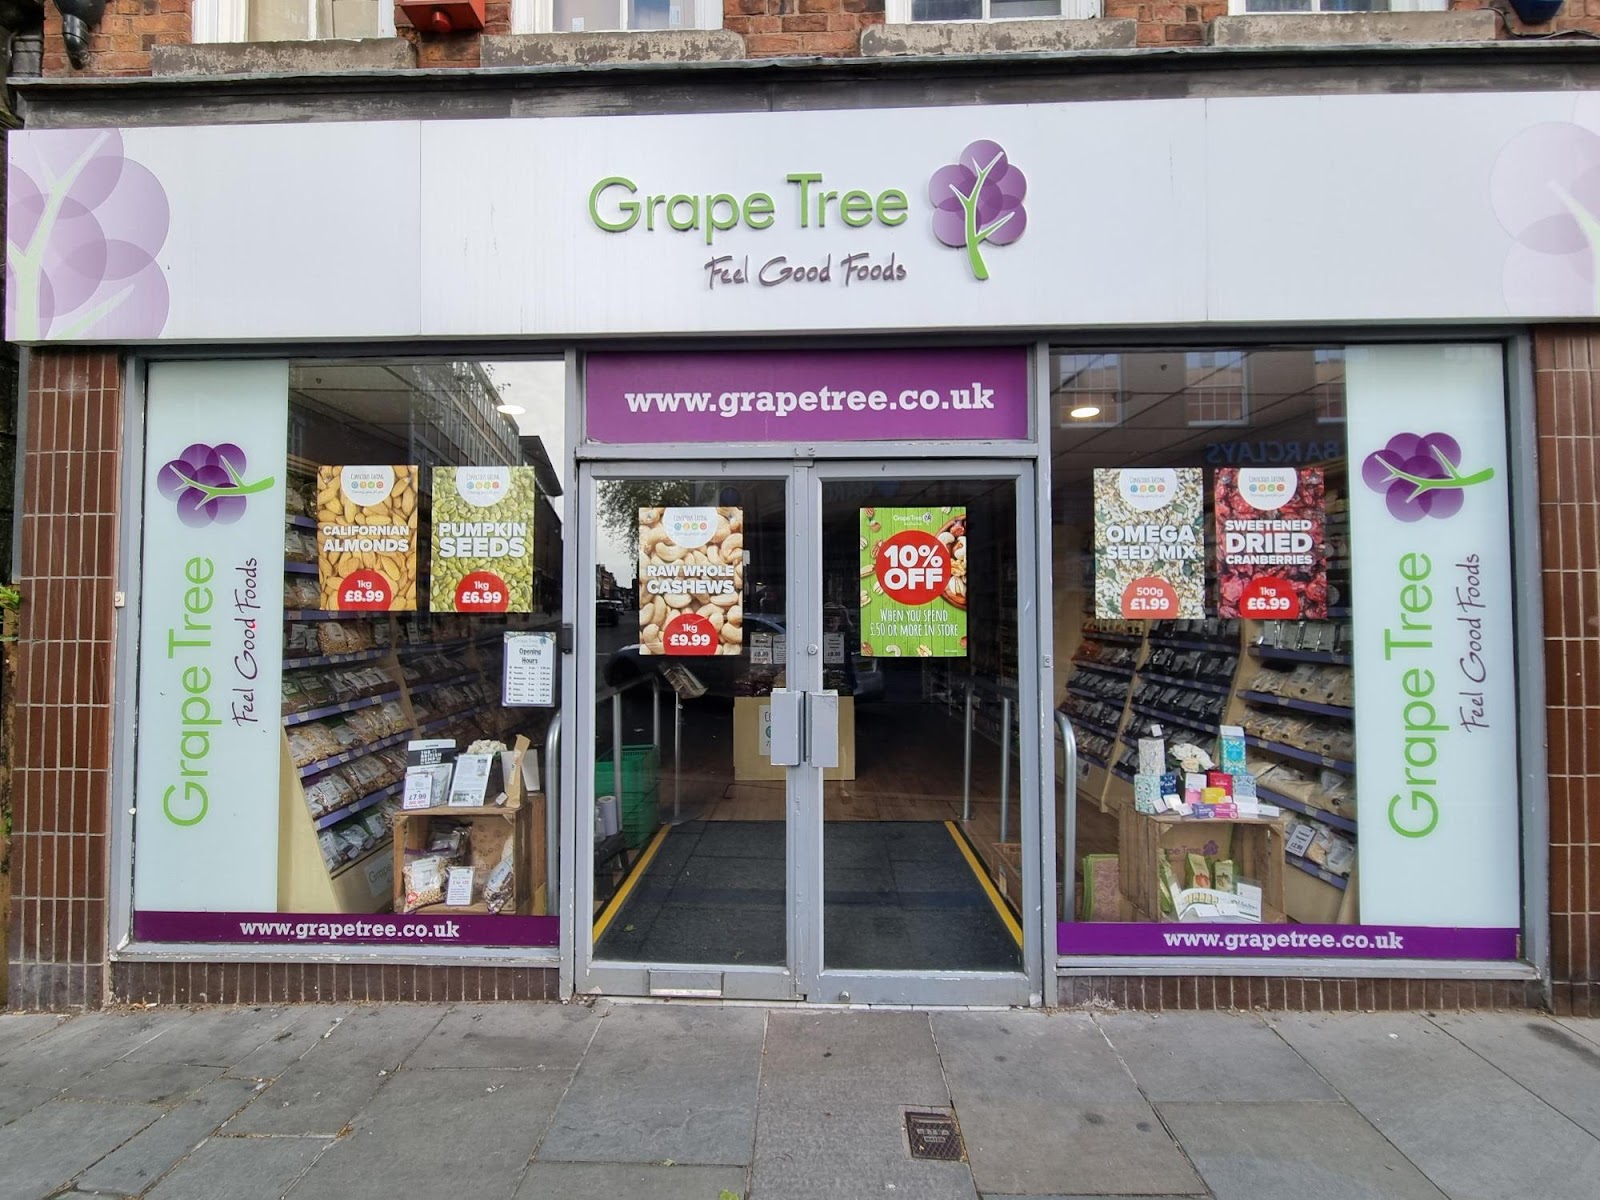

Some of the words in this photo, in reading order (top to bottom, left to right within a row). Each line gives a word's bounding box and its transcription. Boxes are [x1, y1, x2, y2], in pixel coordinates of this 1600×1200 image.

[588, 175, 775, 245] Grape
[786, 172, 909, 229] Tree
[704, 254, 749, 289] Feel
[758, 254, 831, 287] Good
[840, 252, 908, 287] Foods
[624, 382, 995, 418] www.grapetree.co.uk
[322, 525, 410, 536] CALIFORNIAN
[438, 522, 527, 537] PUMPKIN
[1225, 520, 1312, 531] SWEETENED
[1106, 525, 1196, 543] OMEGA
[323, 539, 409, 552] ALMONDS
[438, 538, 526, 557] SEEDS
[1226, 532, 1313, 553] DRIED
[884, 544, 943, 568] 10%
[1106, 545, 1155, 560] SEED
[1159, 545, 1196, 560] MIX
[1226, 554, 1313, 565] CRANBERRIES
[647, 565, 680, 577] RAW
[683, 565, 734, 577] WHOLE
[234, 557, 261, 614] Foods
[356, 580, 373, 590] 1kg
[473, 581, 490, 591] 1kg
[884, 568, 943, 590] OFF
[1455, 553, 1487, 613] Foods
[646, 580, 735, 594] CASHEWS
[1136, 587, 1164, 597] 500g
[1260, 586, 1277, 597] 1kg
[344, 590, 385, 603] £8.99
[461, 591, 502, 604] £6.99
[1130, 597, 1170, 611] £1.99
[1247, 597, 1290, 611] £6.99
[167, 556, 214, 660] Tree
[1384, 552, 1433, 661] Tree
[880, 608, 904, 622] WHEN
[906, 609, 921, 622] YOU
[924, 609, 948, 622] SPEND
[682, 623, 697, 633] 1kg
[870, 622, 885, 636] £50
[888, 624, 898, 637] OR
[900, 624, 922, 637] MORE
[924, 624, 934, 637] IN
[938, 624, 958, 637] STORE
[669, 633, 711, 646] £9.99
[234, 618, 258, 680] Good
[519, 648, 541, 656] Opening
[1456, 617, 1487, 683] Good
[522, 657, 538, 665] Hours
[231, 688, 258, 727] Feel
[1458, 692, 1490, 733] Feel
[162, 666, 223, 827] Grape
[1387, 668, 1450, 839] Grape
[239, 920, 460, 940] www.grapetree.co.uk
[1163, 931, 1404, 951] www.grapetree.co.uk
